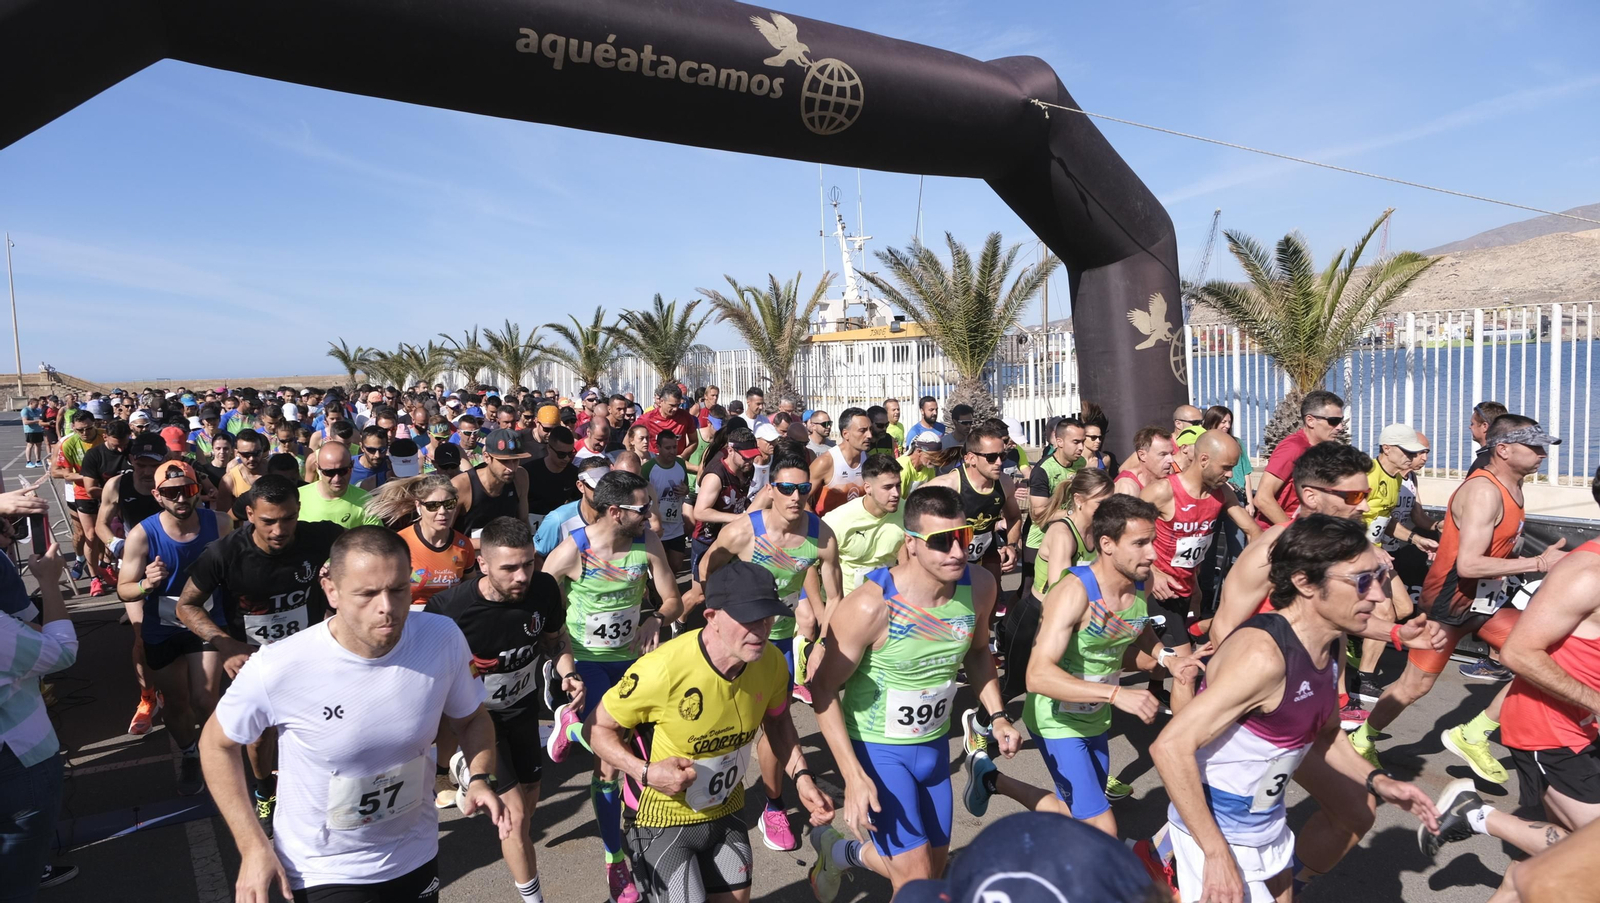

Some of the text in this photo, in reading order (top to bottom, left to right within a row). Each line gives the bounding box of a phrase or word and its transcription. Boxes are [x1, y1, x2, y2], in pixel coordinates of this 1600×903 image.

[515, 27, 785, 99] aquéatacamos
[665, 508, 678, 518] 84
[254, 620, 300, 640] 438
[592, 618, 632, 640] 433
[492, 672, 531, 701] 440
[896, 697, 948, 726] 396
[708, 764, 739, 796] 60
[358, 780, 405, 816] 57
